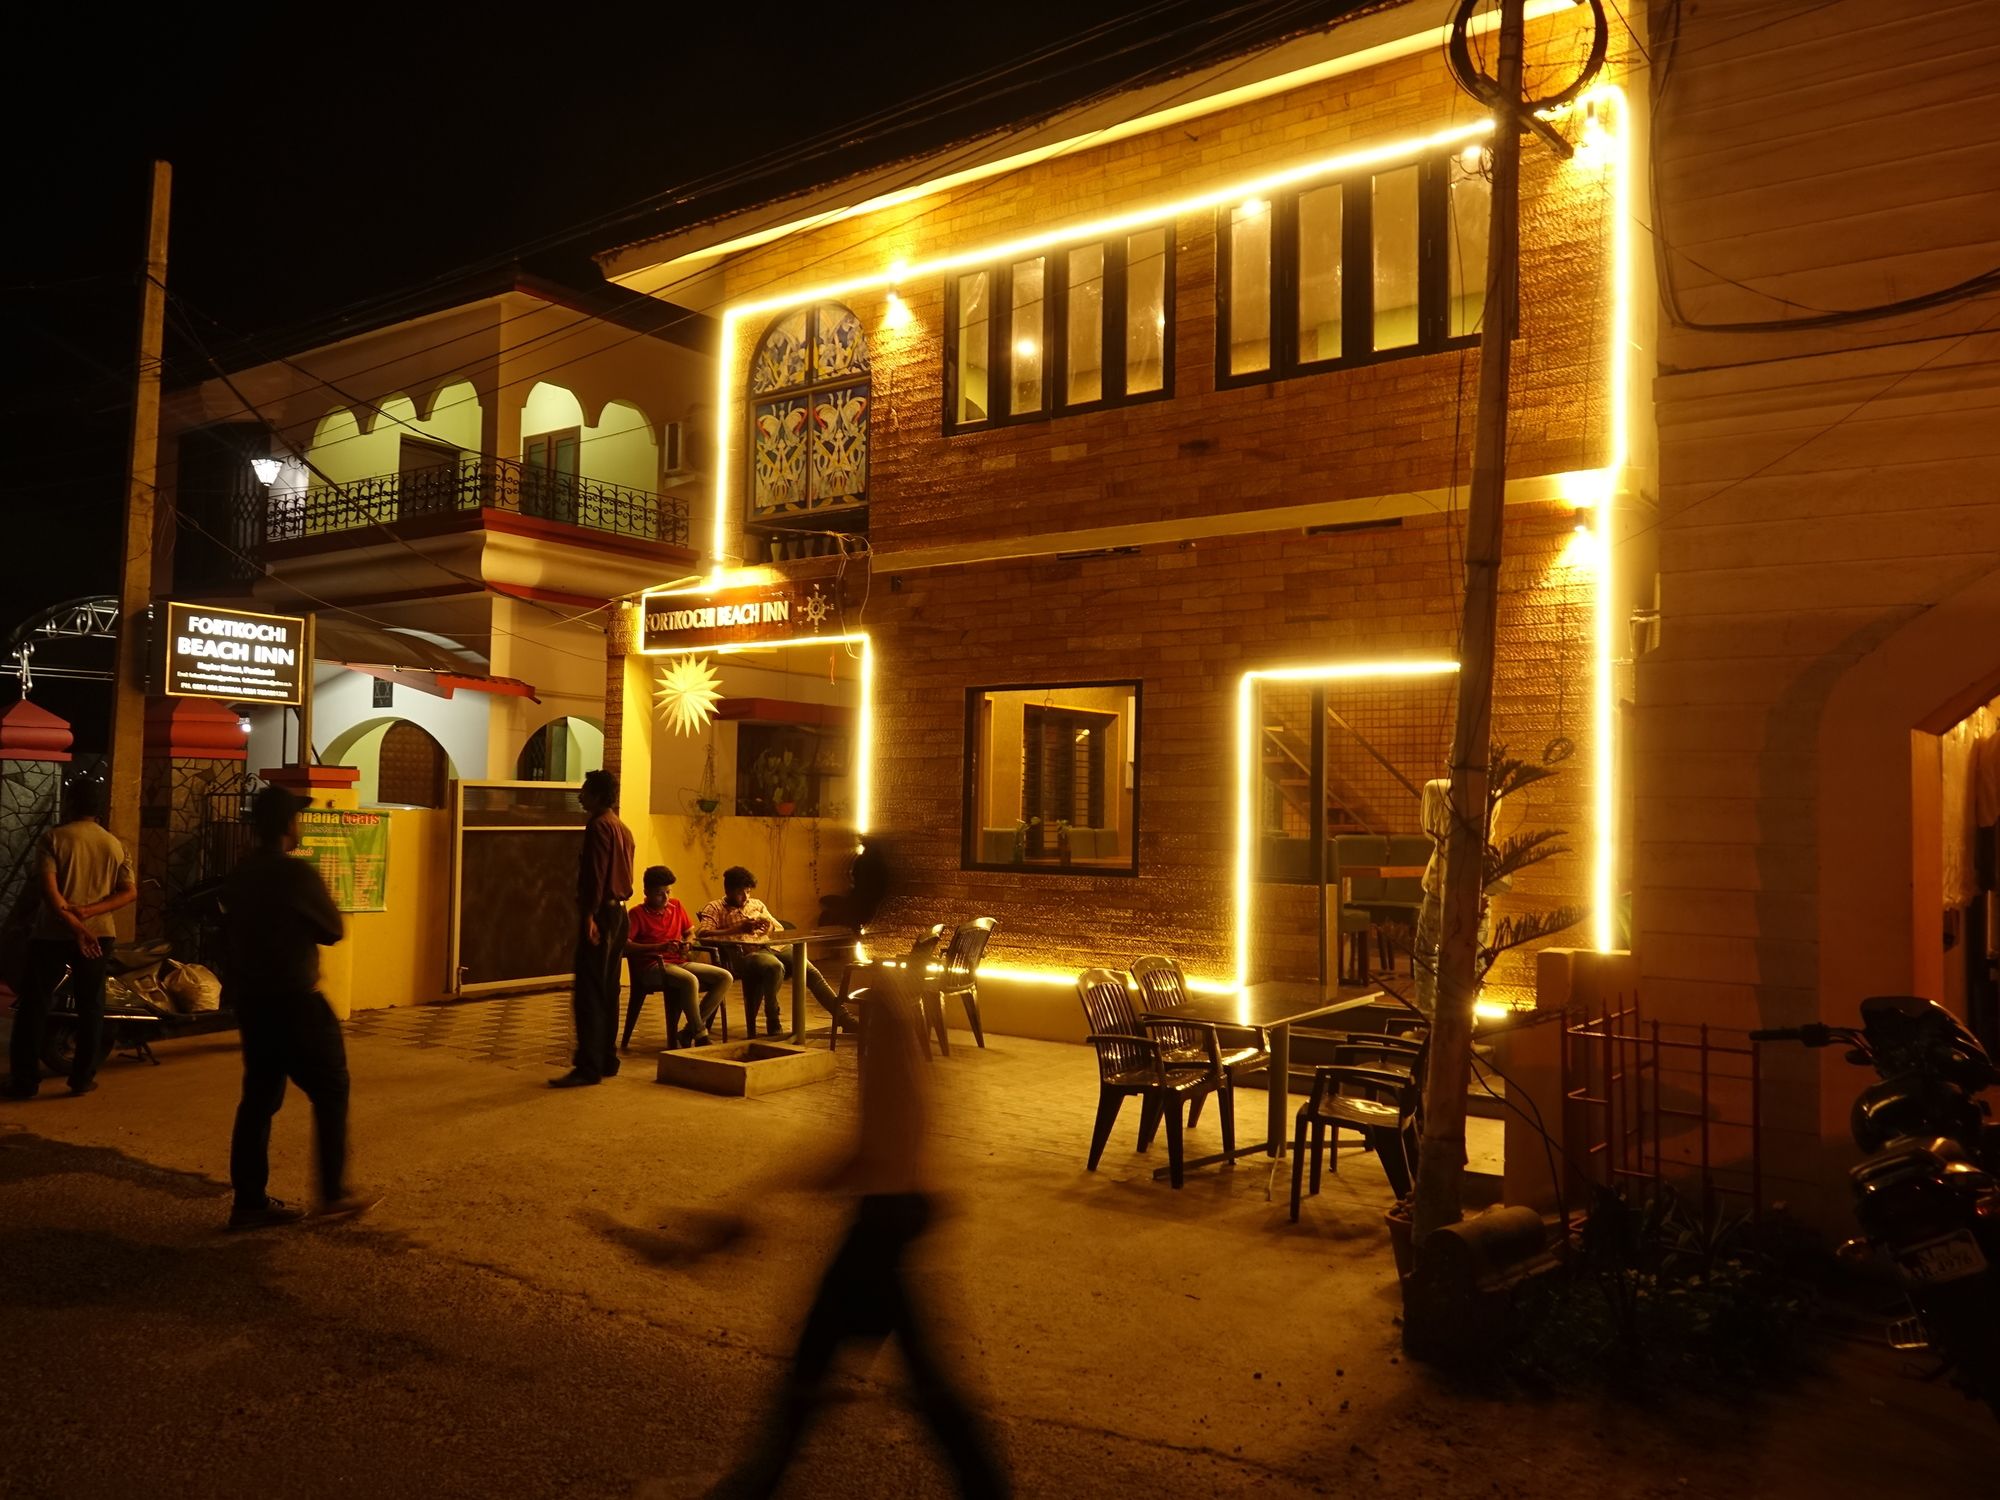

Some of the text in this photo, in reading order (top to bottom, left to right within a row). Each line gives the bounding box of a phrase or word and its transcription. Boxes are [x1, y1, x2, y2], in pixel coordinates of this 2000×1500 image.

[717, 603, 760, 627] BEACH
[762, 600, 789, 622] INN
[188, 616, 287, 643] FORTKOCHI
[177, 636, 294, 666] BEACH INN
